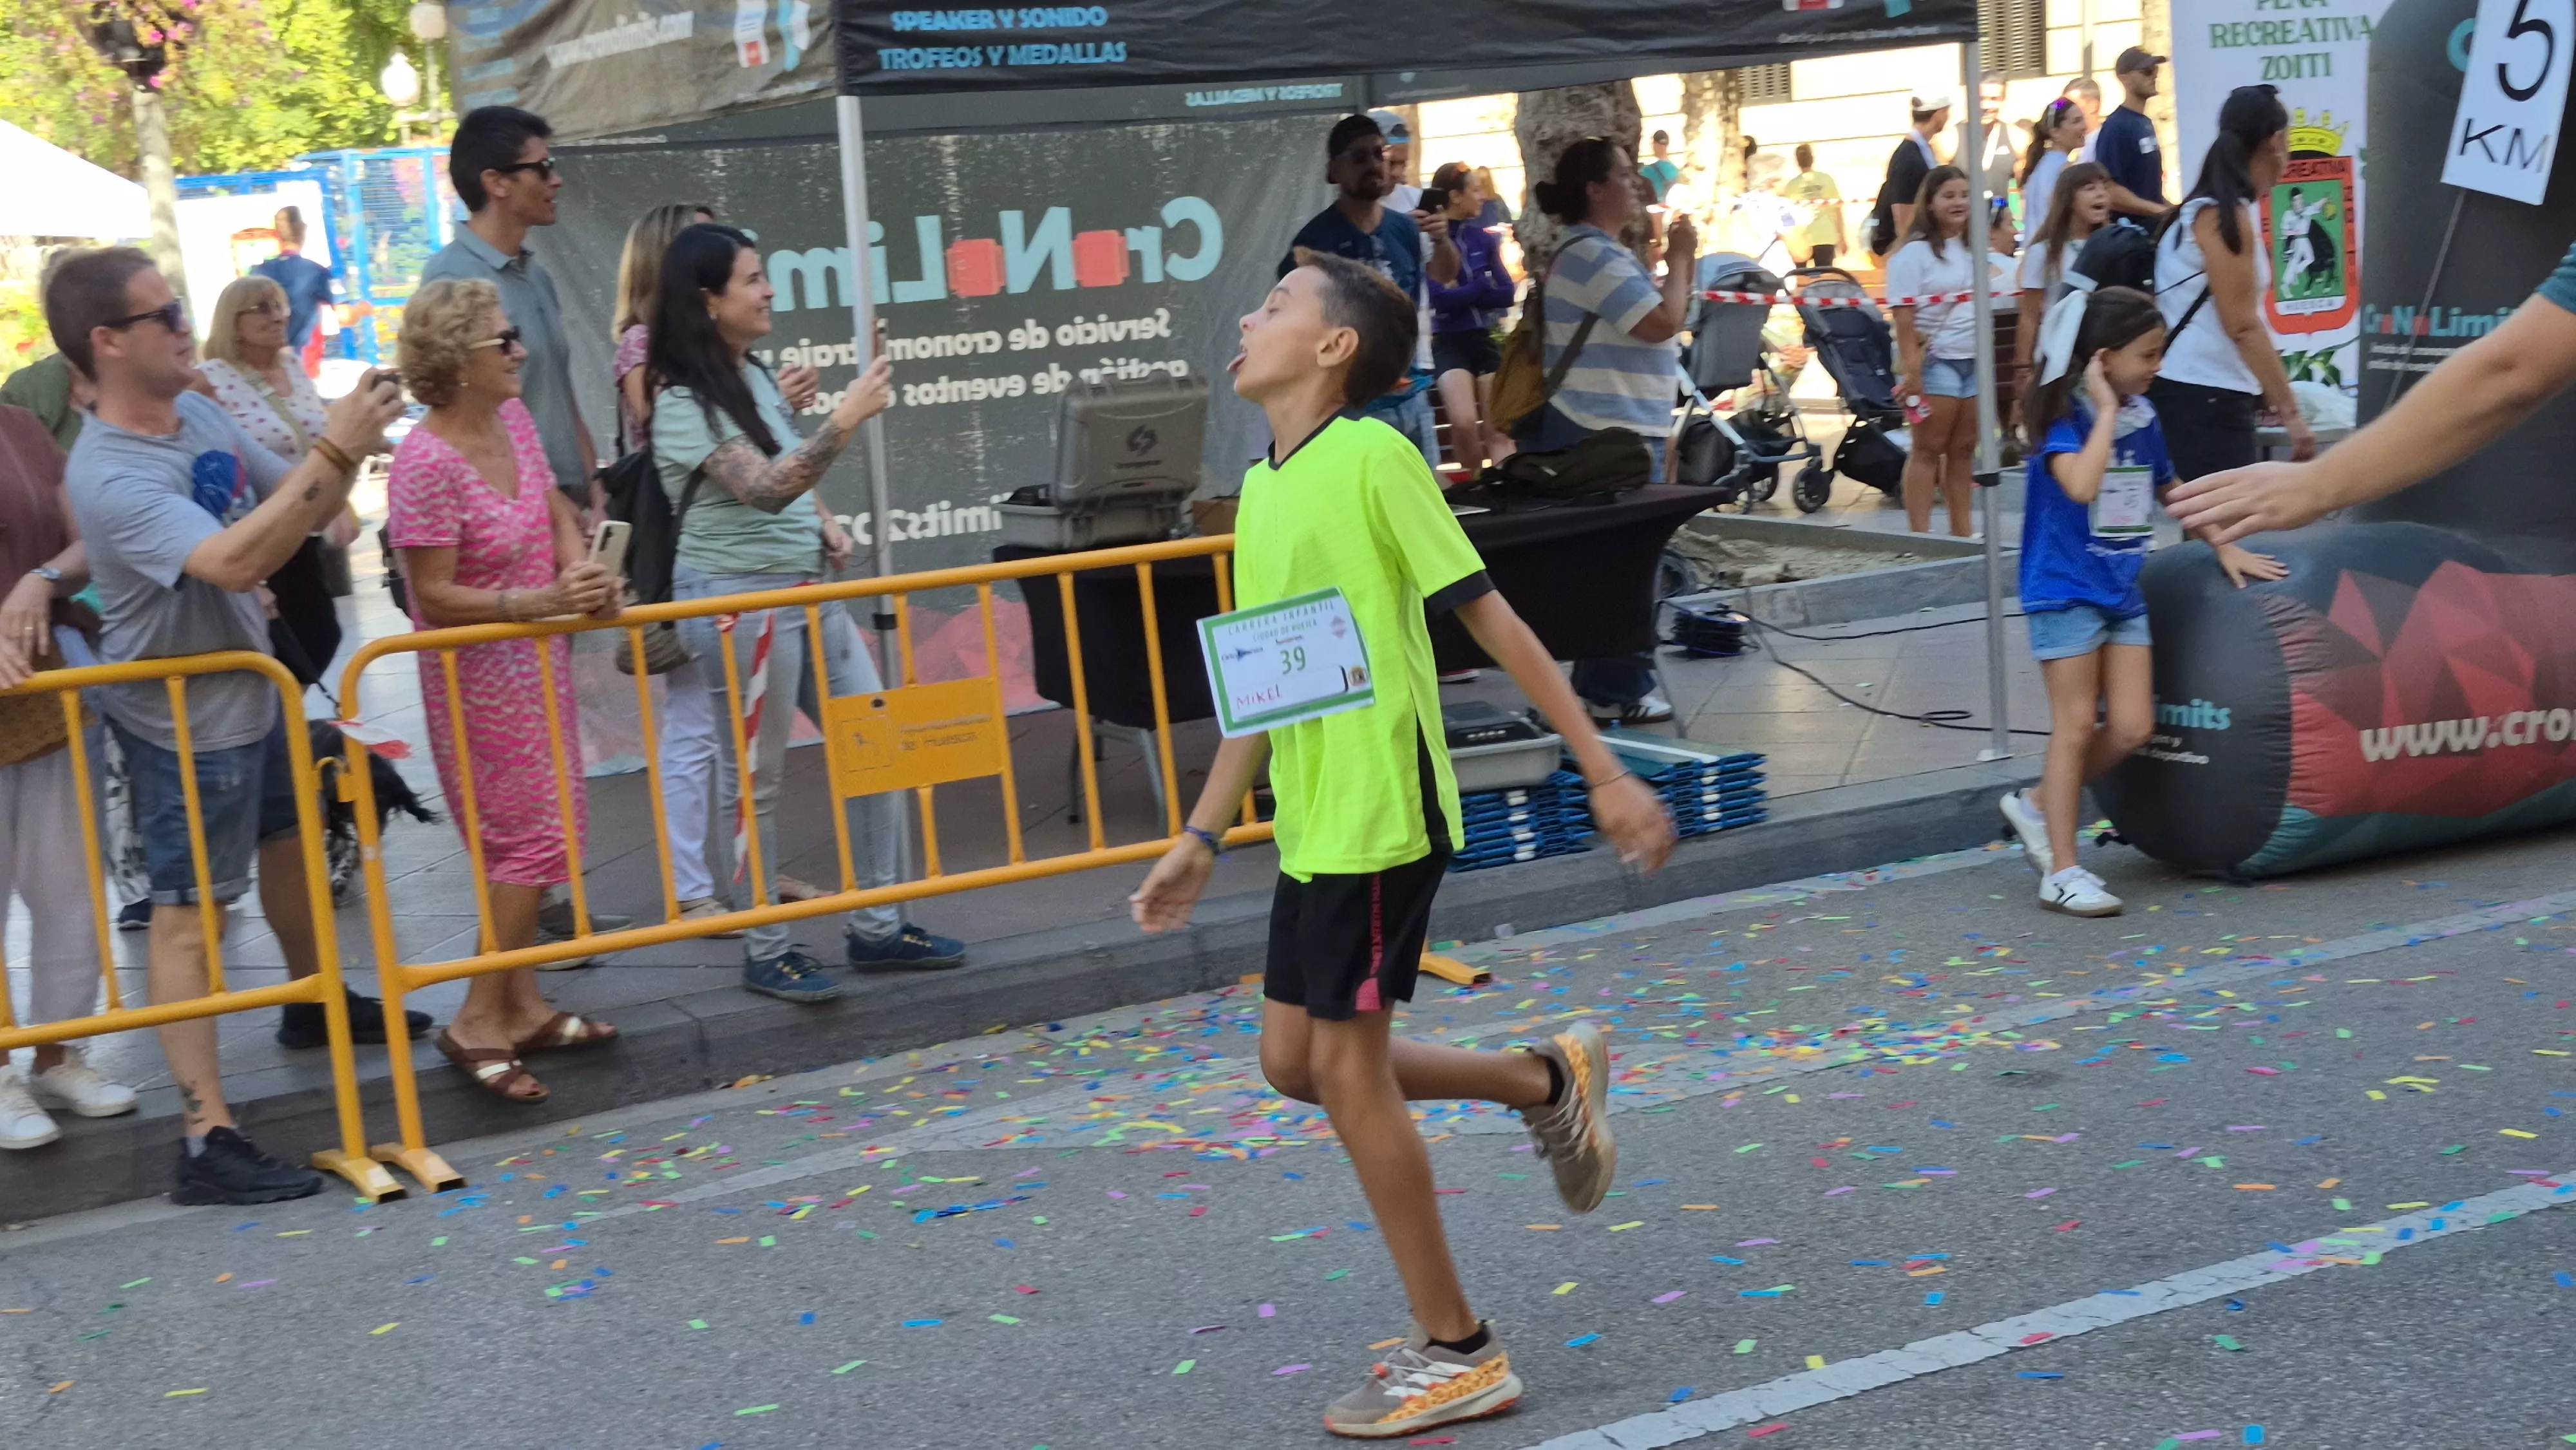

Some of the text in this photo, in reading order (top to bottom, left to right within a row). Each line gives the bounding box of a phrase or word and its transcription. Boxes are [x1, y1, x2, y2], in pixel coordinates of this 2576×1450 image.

[890, 6, 1110, 32] SPEAKER Y SONIDO
[2208, 14, 2372, 49] RECREATIVA
[876, 41, 1128, 70] TROFEOS Y MEDALLAS
[2496, 0, 2555, 102] 5
[2458, 117, 2552, 174] KM
[1227, 599, 1335, 636] CARRERA INFANTIL
[1280, 645, 1307, 675] 39
[2360, 708, 2576, 762] www.cro
